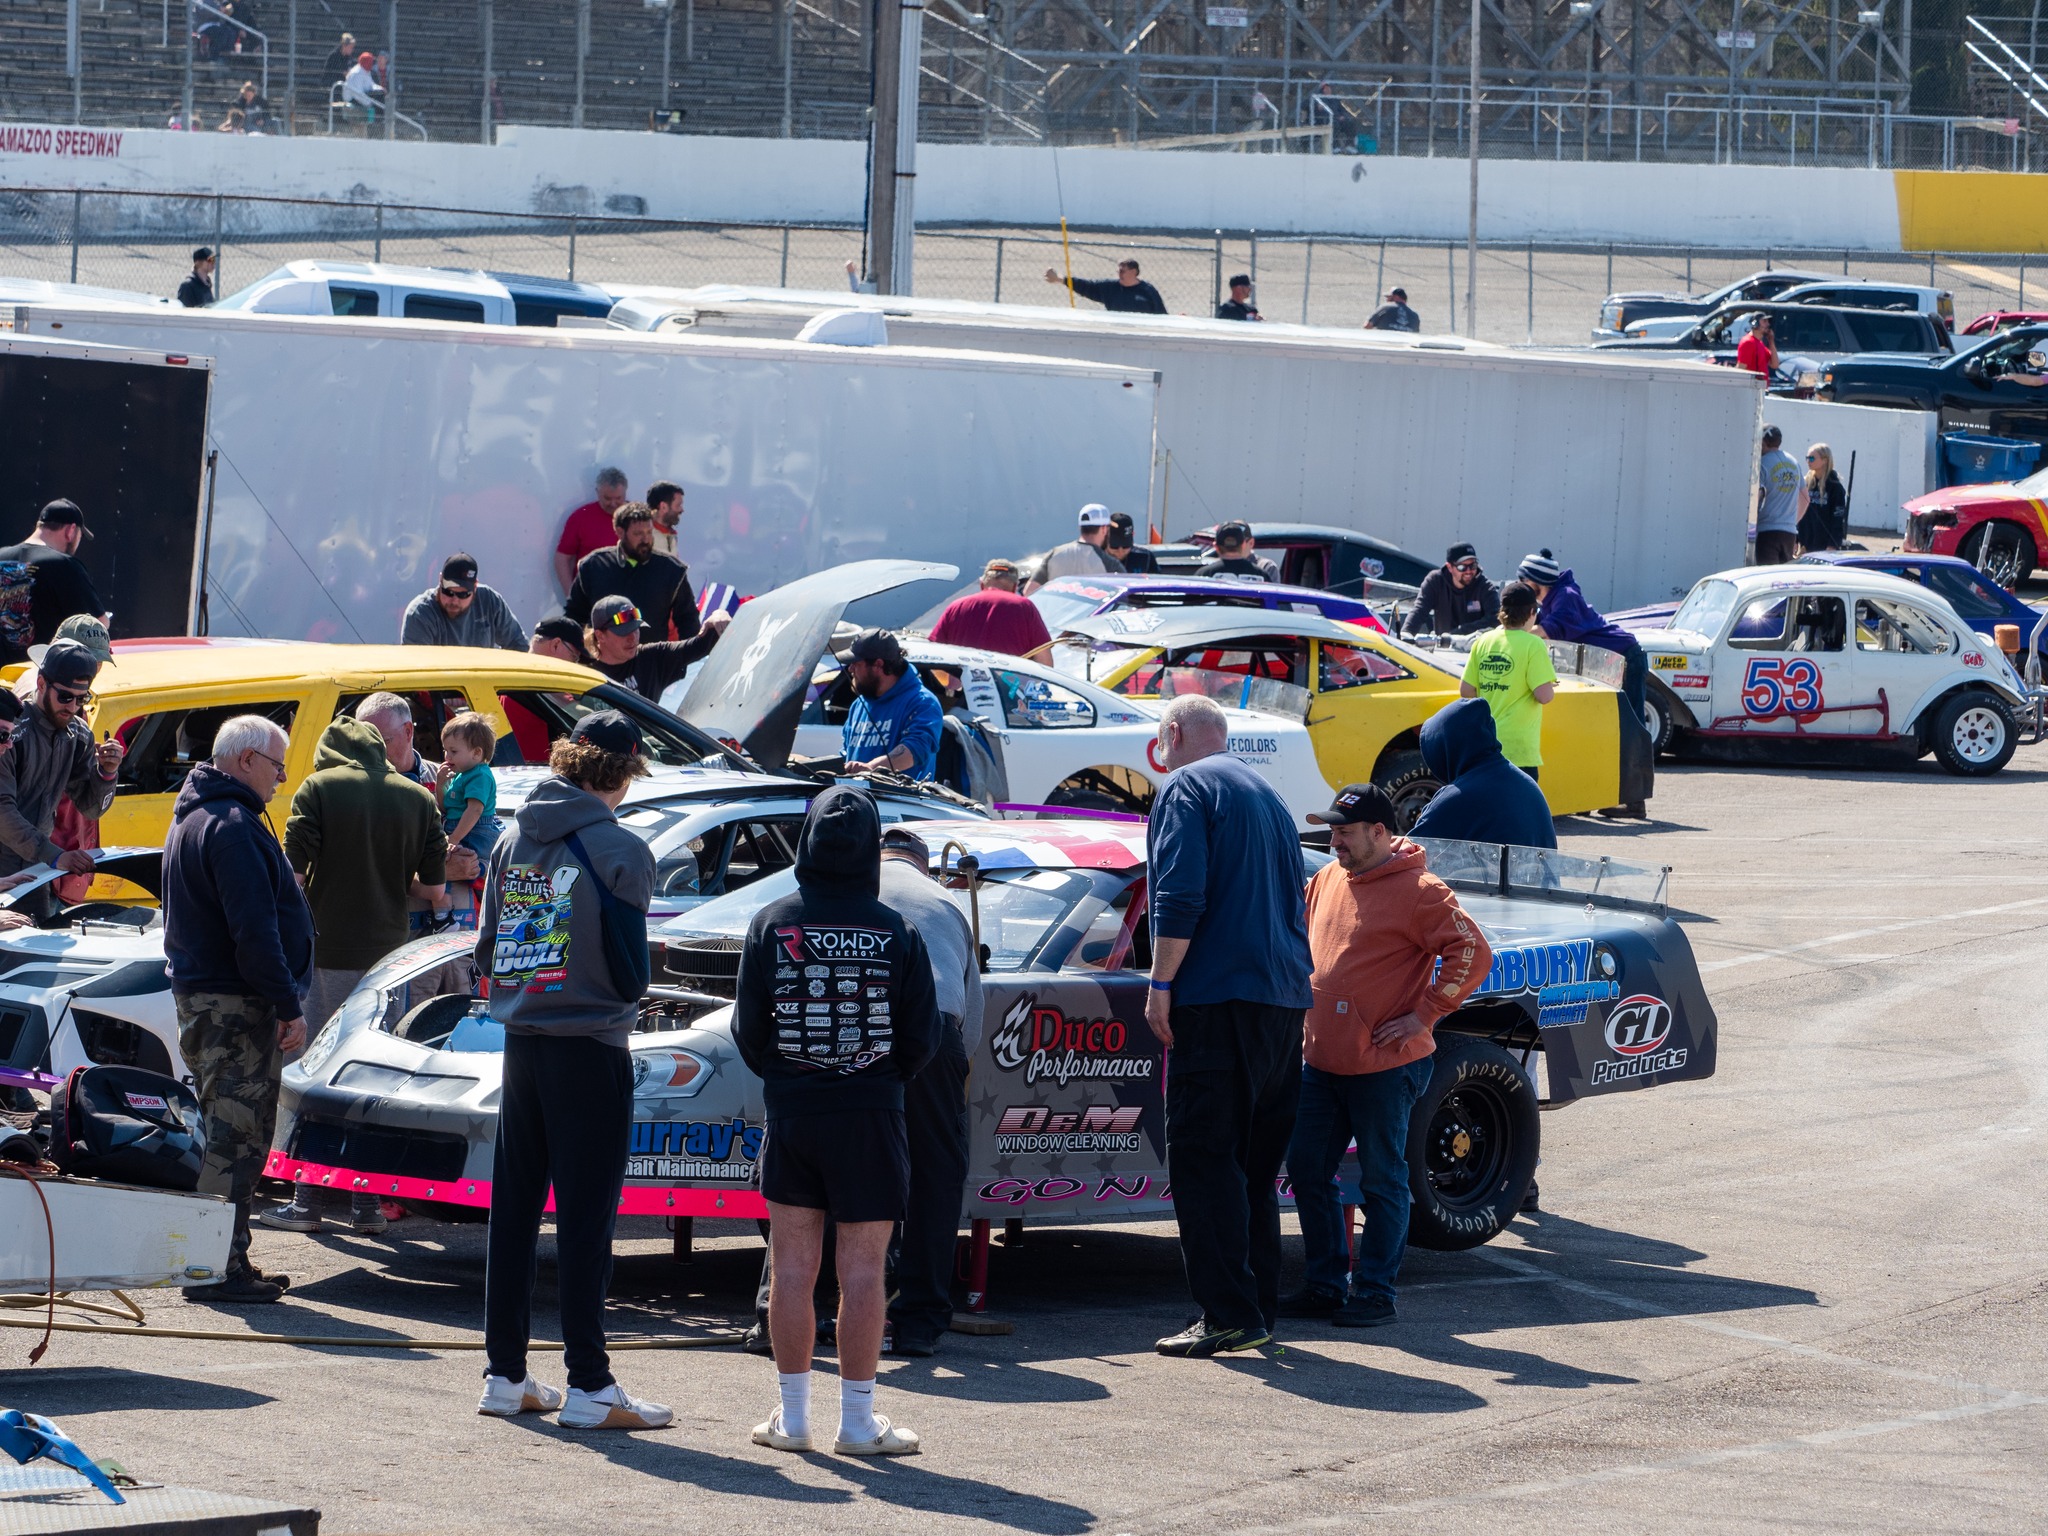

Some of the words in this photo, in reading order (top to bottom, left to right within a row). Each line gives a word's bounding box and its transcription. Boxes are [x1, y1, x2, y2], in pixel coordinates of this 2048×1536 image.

[56, 130, 123, 158] SPEEDWAY
[1948, 420, 1991, 430] SILVERADO
[1742, 658, 1823, 716] 53
[1384, 763, 1432, 798] Hoosi
[805, 932, 892, 952] ROWDY
[835, 966, 860, 974] CURB
[776, 1003, 799, 1013] XYZ
[1538, 984, 1609, 1007] CONSTRUCTION
[1030, 1008, 1127, 1052] Duco
[1538, 1005, 1588, 1029] CONCRETE
[839, 1043, 861, 1053] KSE
[1026, 1048, 1152, 1086] Performance
[1456, 1060, 1524, 1093] Hoosier
[1591, 1049, 1687, 1085] Products
[129, 1096, 161, 1106] IMPSON
[630, 1119, 764, 1161] urray's
[997, 1134, 1064, 1152] WINDOW
[1065, 1133, 1140, 1151] CLEANING
[1432, 1201, 1500, 1234] Hoosier
